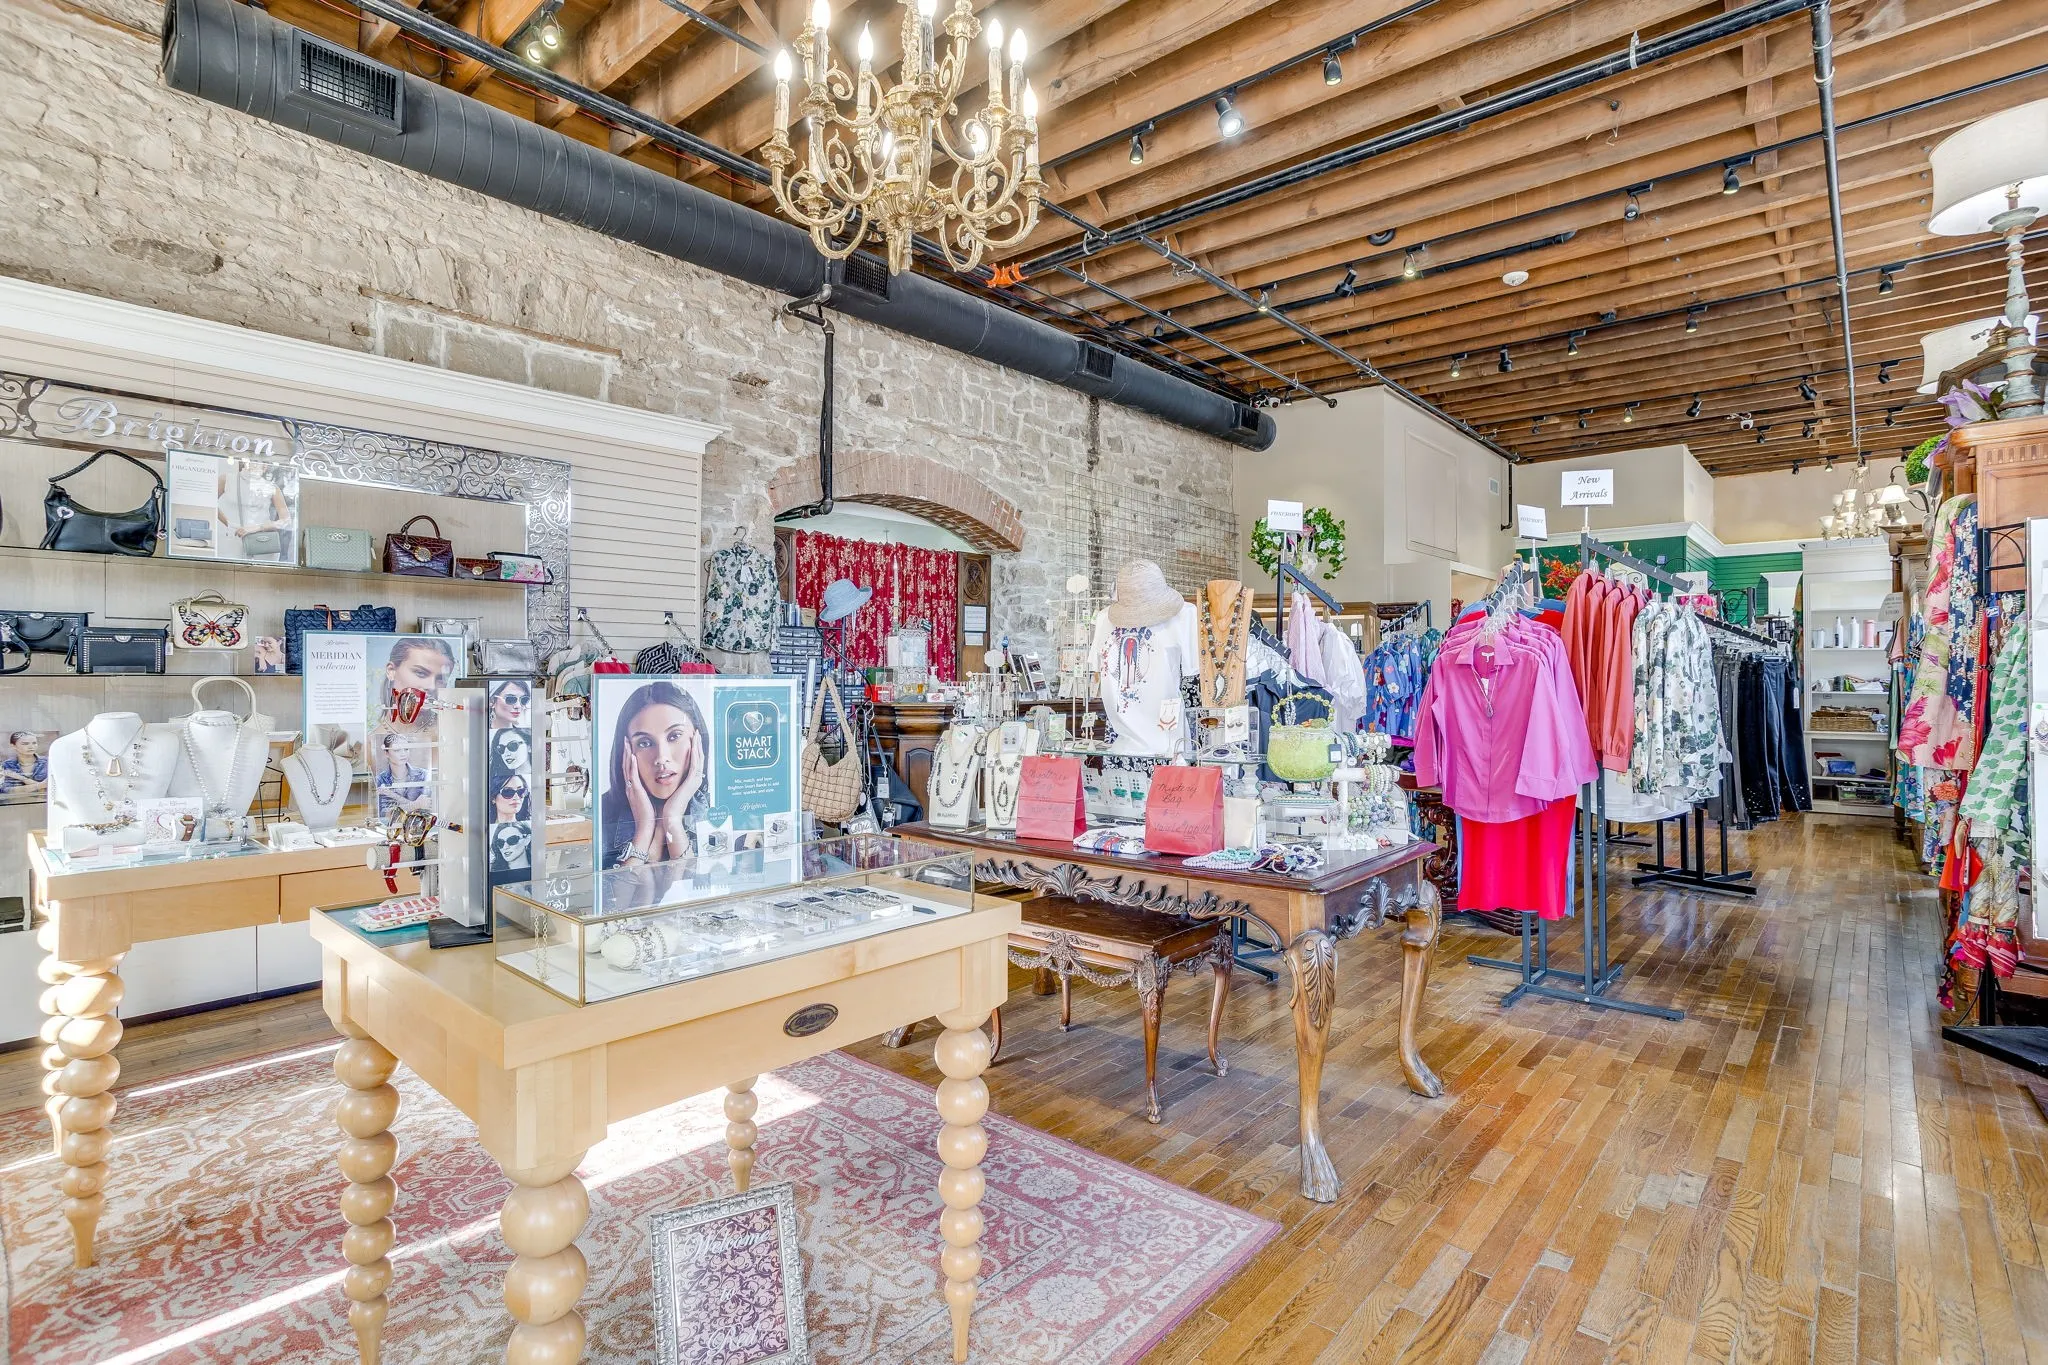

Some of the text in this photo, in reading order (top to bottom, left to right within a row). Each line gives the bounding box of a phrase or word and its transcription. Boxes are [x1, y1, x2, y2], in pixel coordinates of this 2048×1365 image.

[52, 397, 276, 457] Brighton
[1577, 476, 1600, 485] New
[1570, 488, 1608, 500] Arrivals
[311, 651, 362, 660] MERIDIAN
[316, 662, 356, 671] collection
[735, 735, 773, 748] SMART
[737, 747, 772, 760] STACK
[1157, 782, 1198, 799] Mystery
[1162, 794, 1183, 808] Bag
[684, 1220, 771, 1260] Welcome
[721, 1288, 736, 1301] to
[707, 1321, 761, 1352] Red
